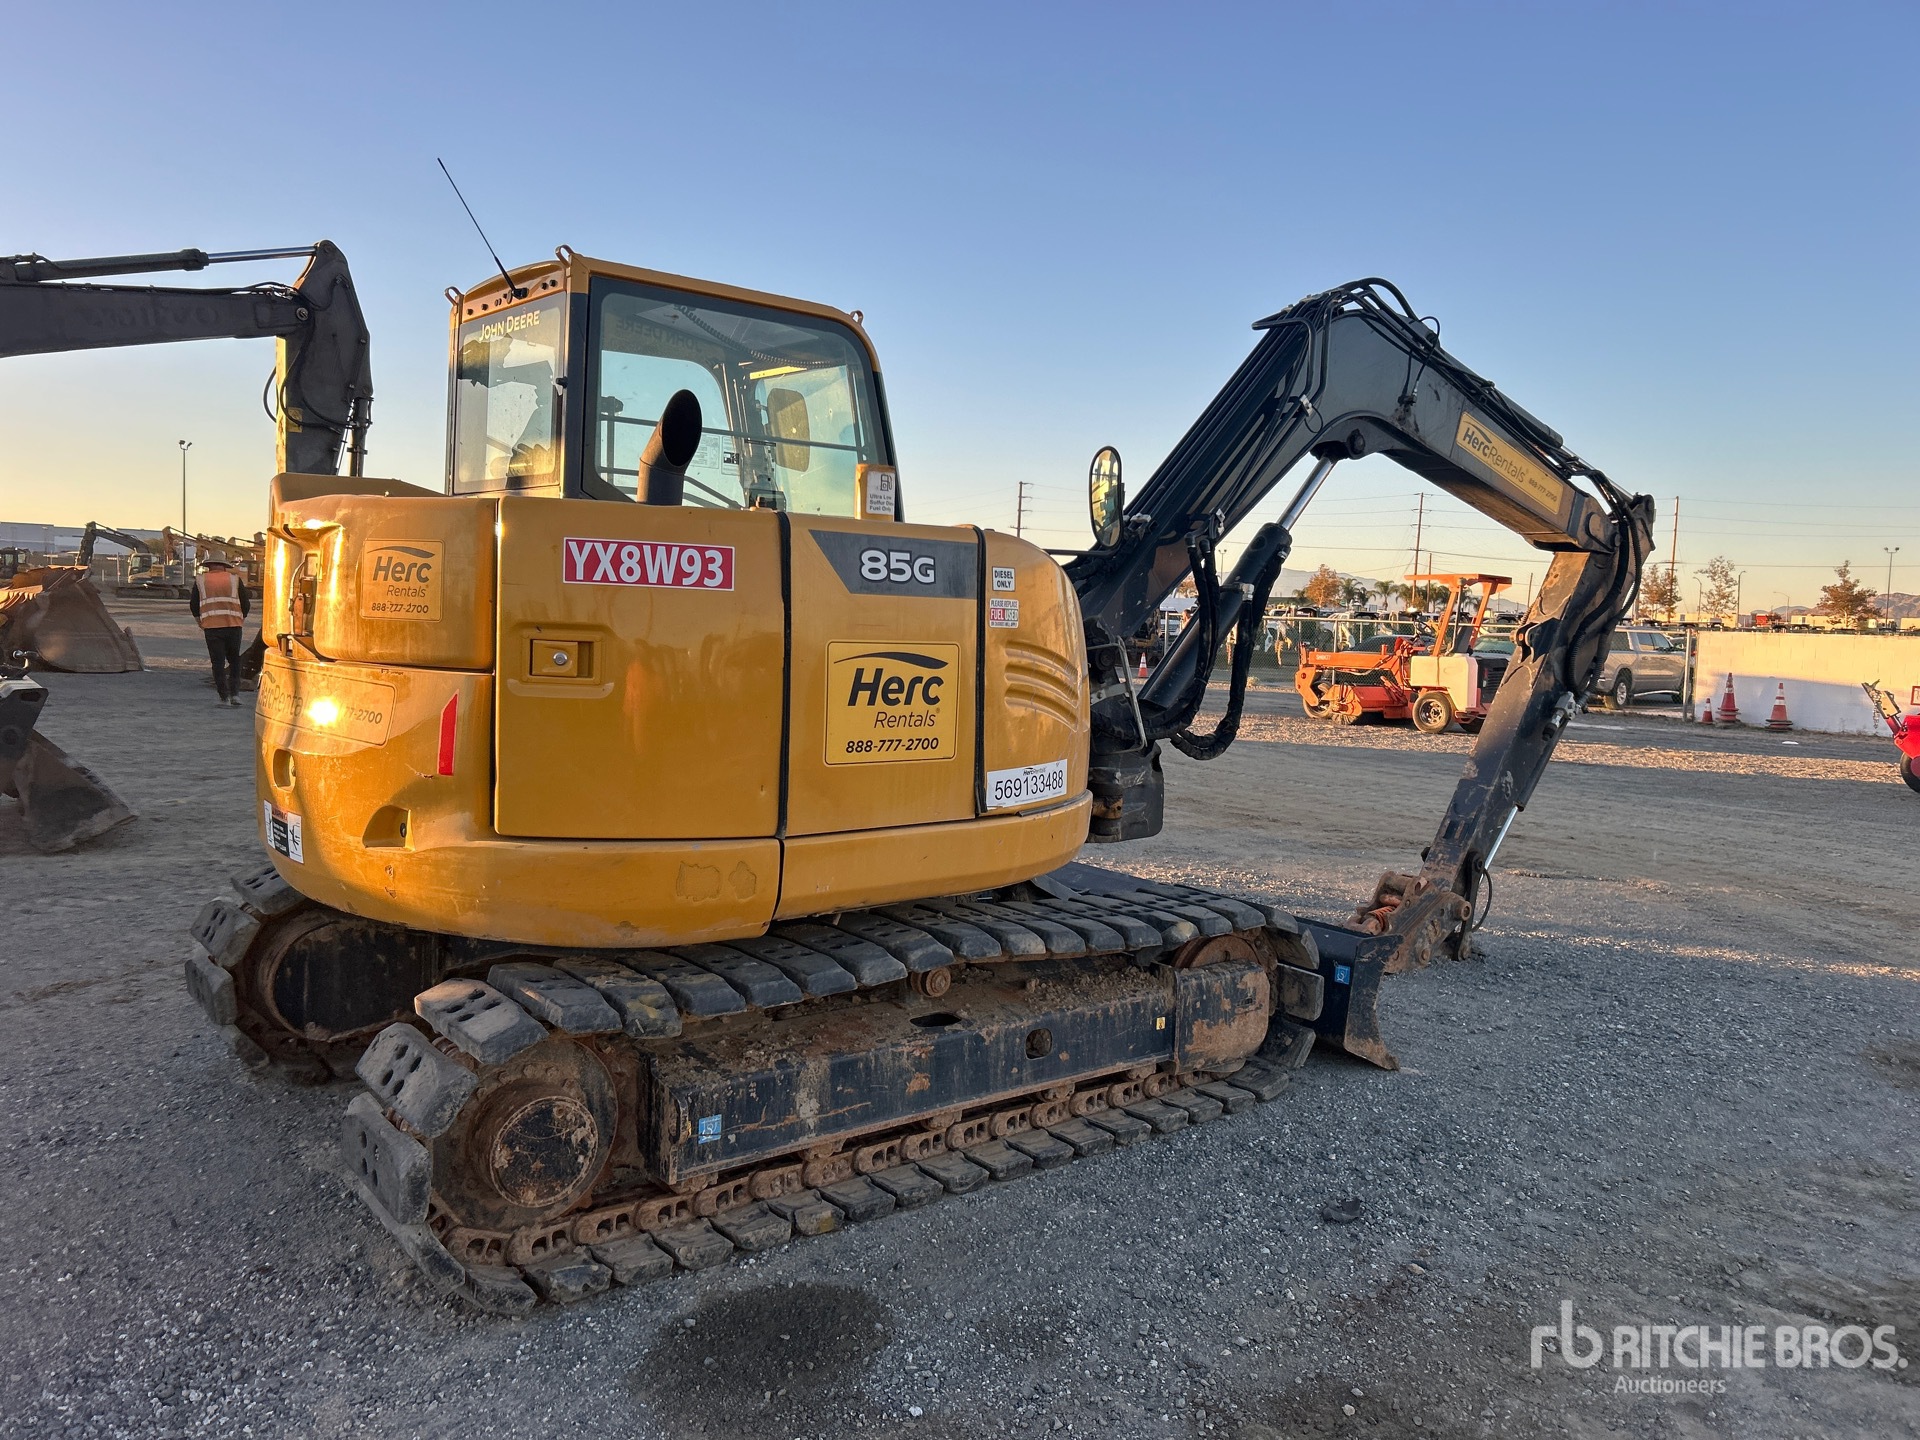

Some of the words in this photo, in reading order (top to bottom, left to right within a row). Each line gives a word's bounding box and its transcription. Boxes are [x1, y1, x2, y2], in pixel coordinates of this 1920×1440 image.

[479, 320, 505, 342] JOHN
[507, 310, 541, 333] DEERE
[372, 556, 432, 583] Herc
[568, 541, 724, 587] YX8W93
[860, 550, 936, 584] 85G
[994, 570, 1013, 579] DIESEL
[386, 585, 427, 598] Rentals
[996, 580, 1011, 588] ONLY
[371, 602, 429, 614] 888-777-2700
[991, 600, 1004, 608] PLEASE
[990, 609, 1004, 620] FUEL
[1005, 609, 1018, 621] USED
[848, 668, 944, 706] Herc
[874, 710, 936, 728] Rentals
[846, 738, 939, 753] 888-777-2700
[995, 770, 1063, 800] 569133488
